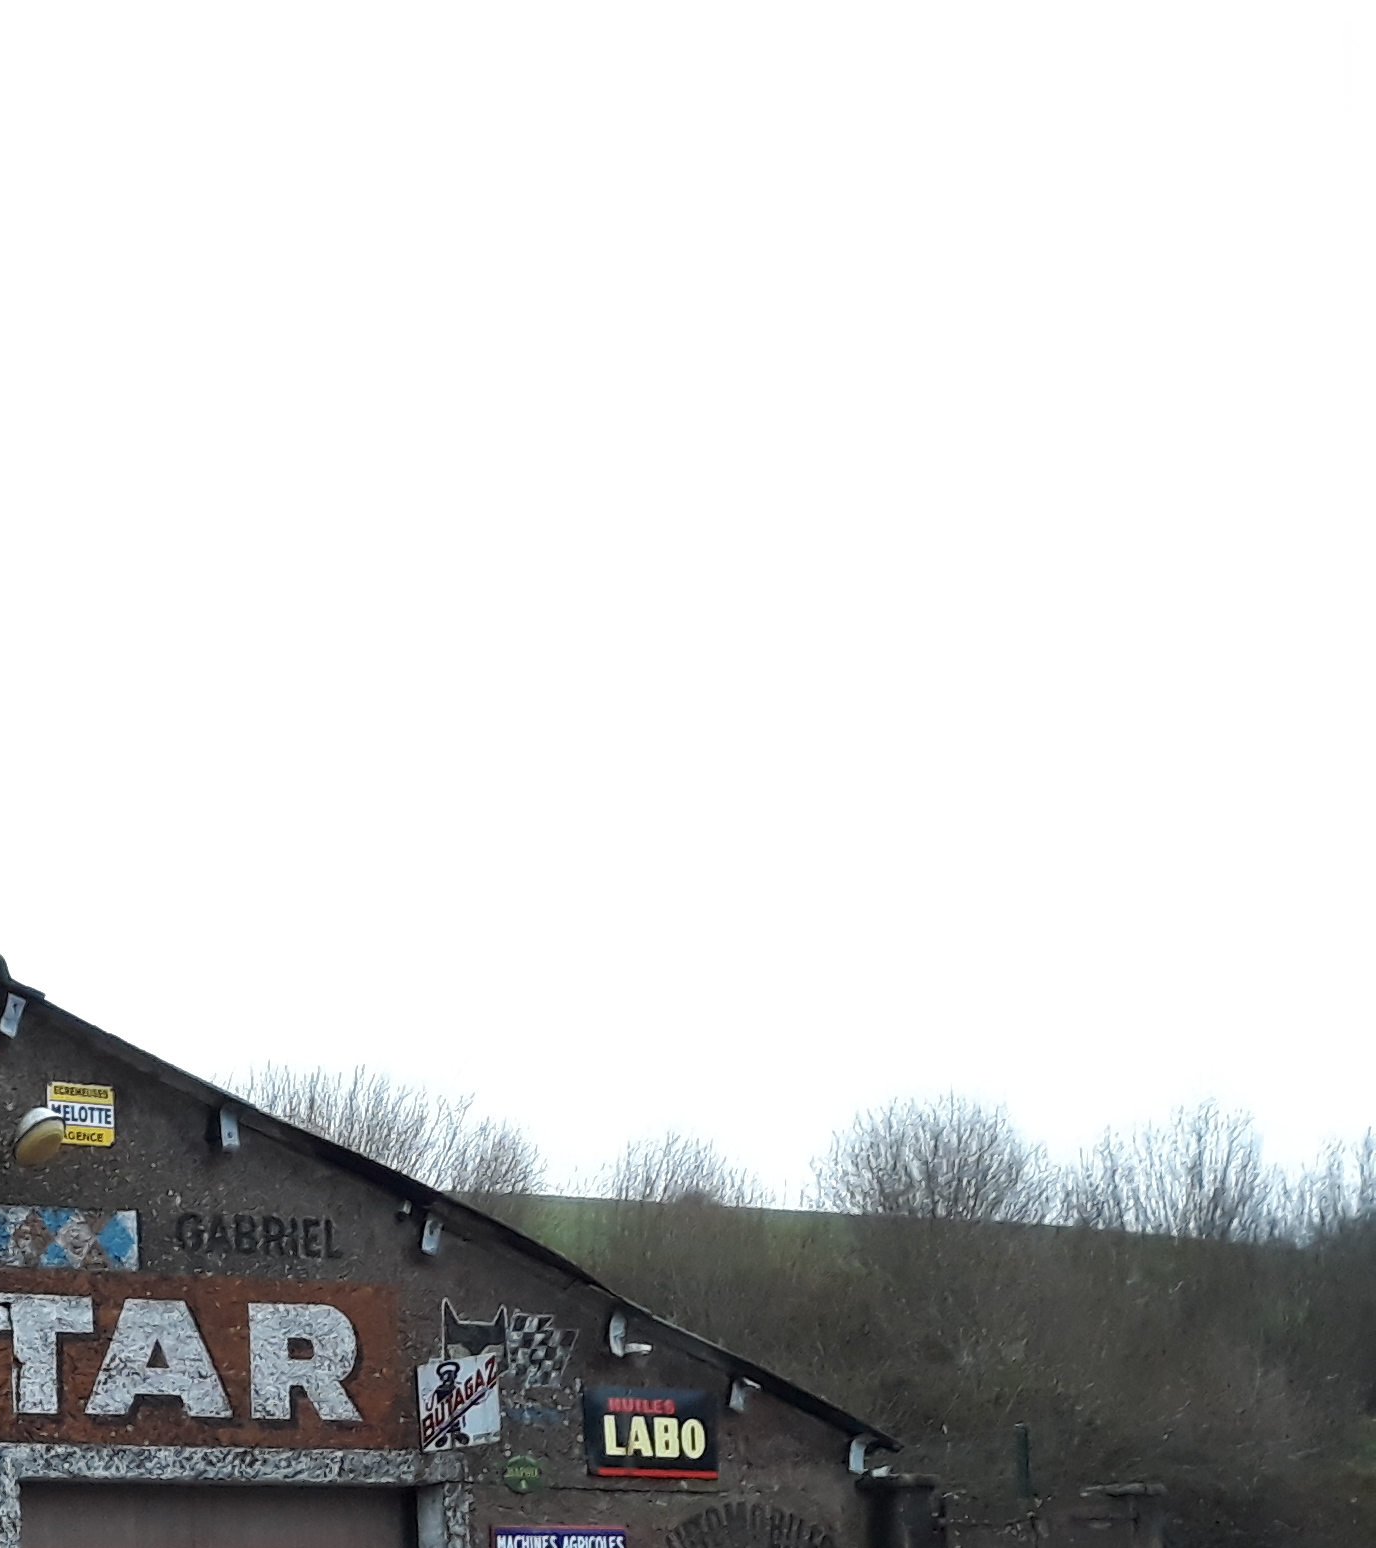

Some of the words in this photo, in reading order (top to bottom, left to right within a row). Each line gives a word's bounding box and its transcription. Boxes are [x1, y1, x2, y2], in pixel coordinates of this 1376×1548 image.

[63, 1131, 104, 1142] GENCE
[176, 1212, 344, 1258] GABRIEL
[422, 1355, 497, 1444] BUTAGAZ
[608, 1397, 676, 1414] HUILES
[604, 1414, 706, 1459] LABO
